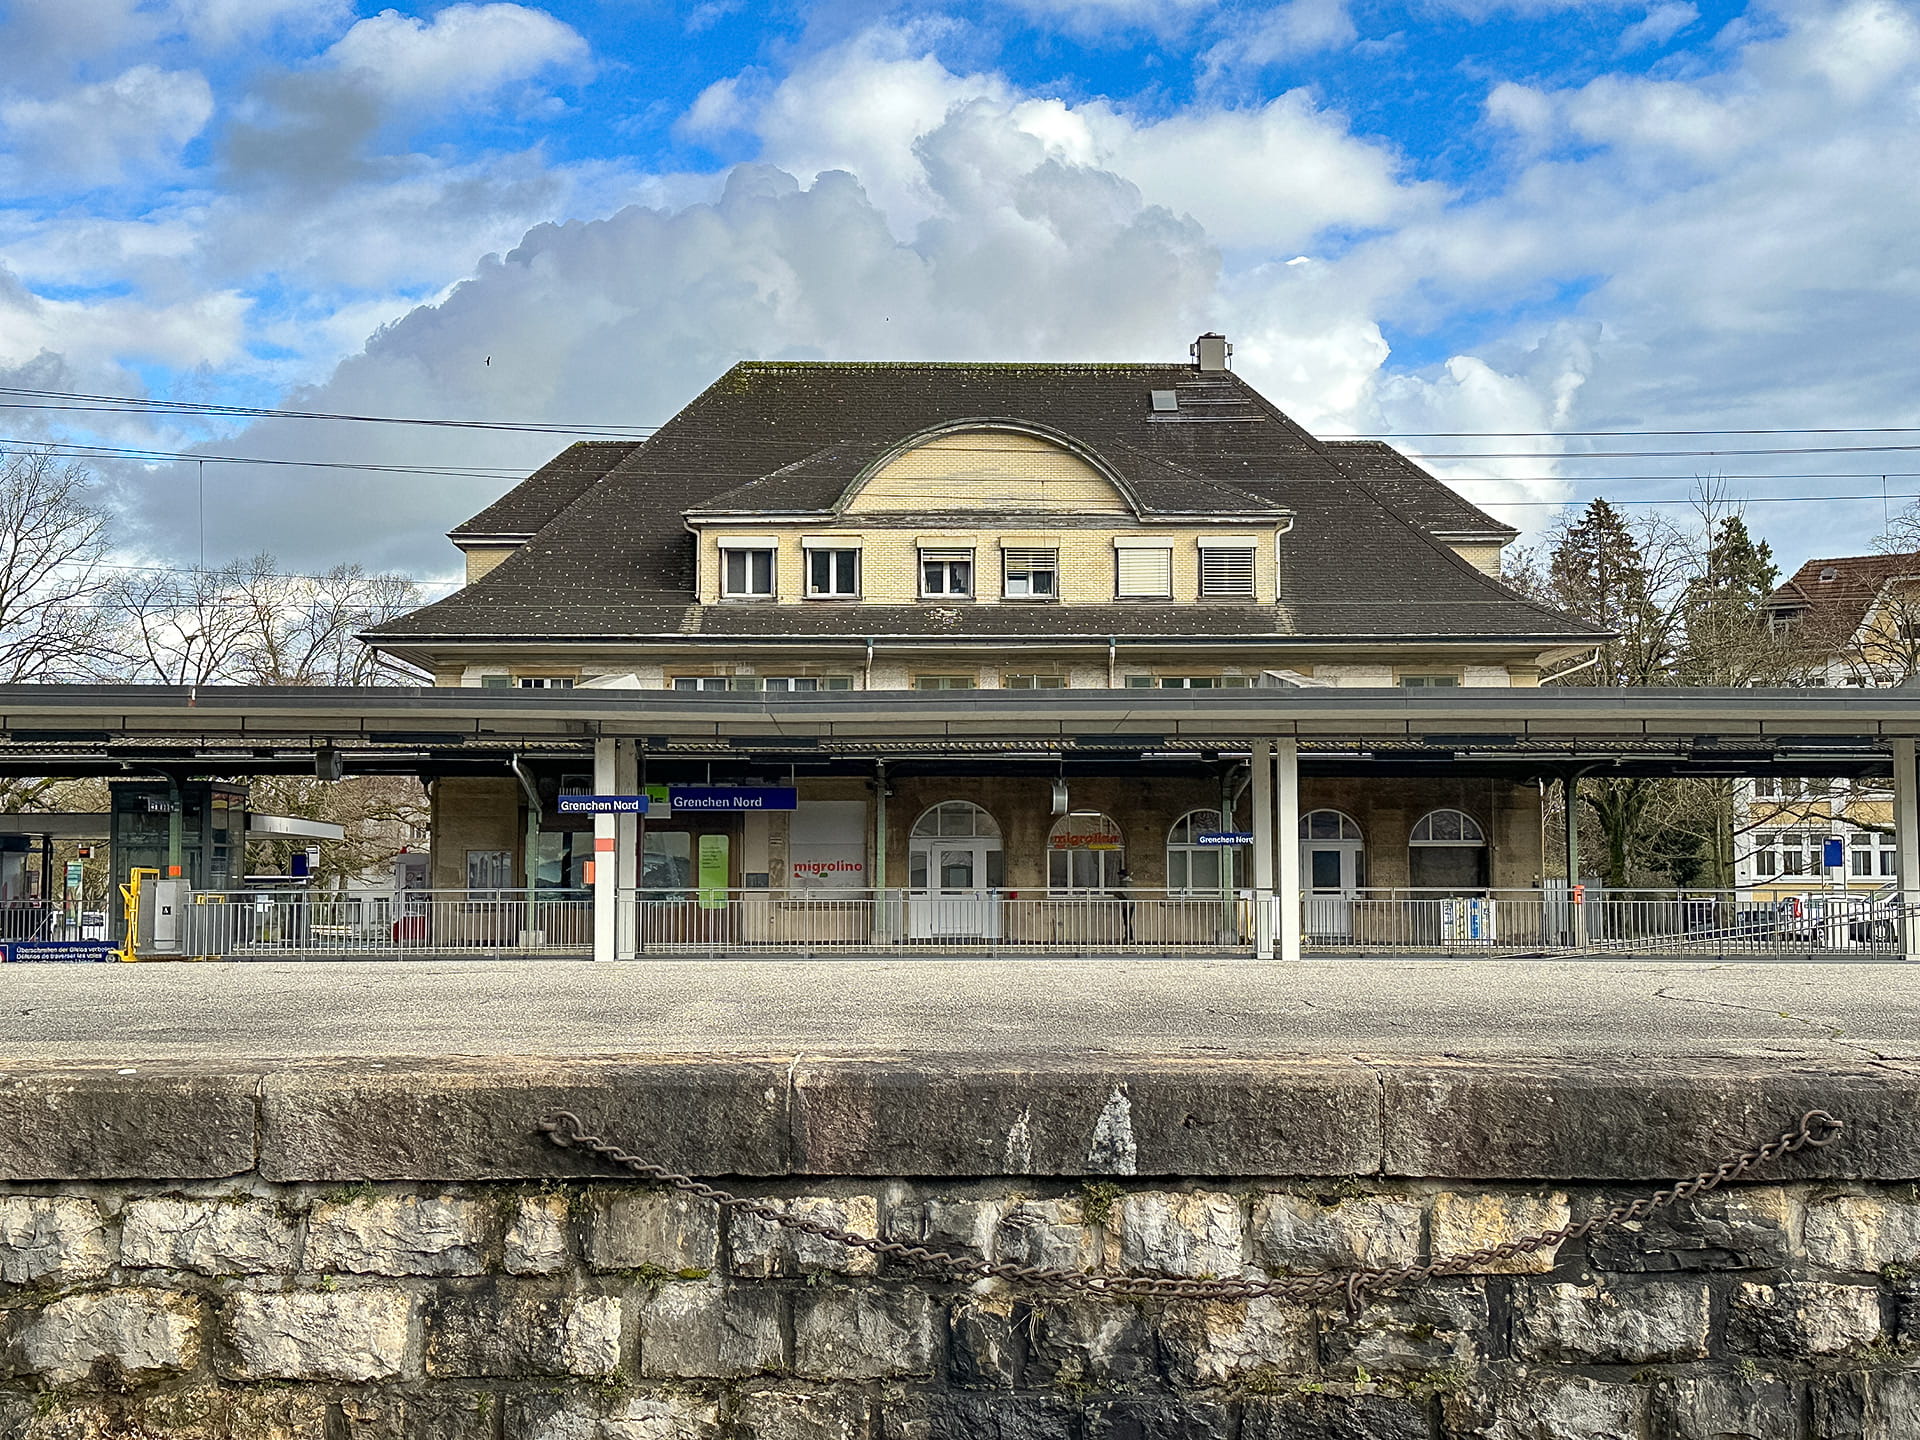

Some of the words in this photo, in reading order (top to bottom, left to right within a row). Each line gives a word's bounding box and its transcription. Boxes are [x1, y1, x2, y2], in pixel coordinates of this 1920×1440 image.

[560, 800, 612, 811] Grenchen
[613, 800, 639, 810] Nord
[673, 796, 730, 807] Grenchen
[733, 796, 762, 807] Nord
[1199, 835, 1235, 844] Grenchen
[793, 859, 863, 875] migrolino
